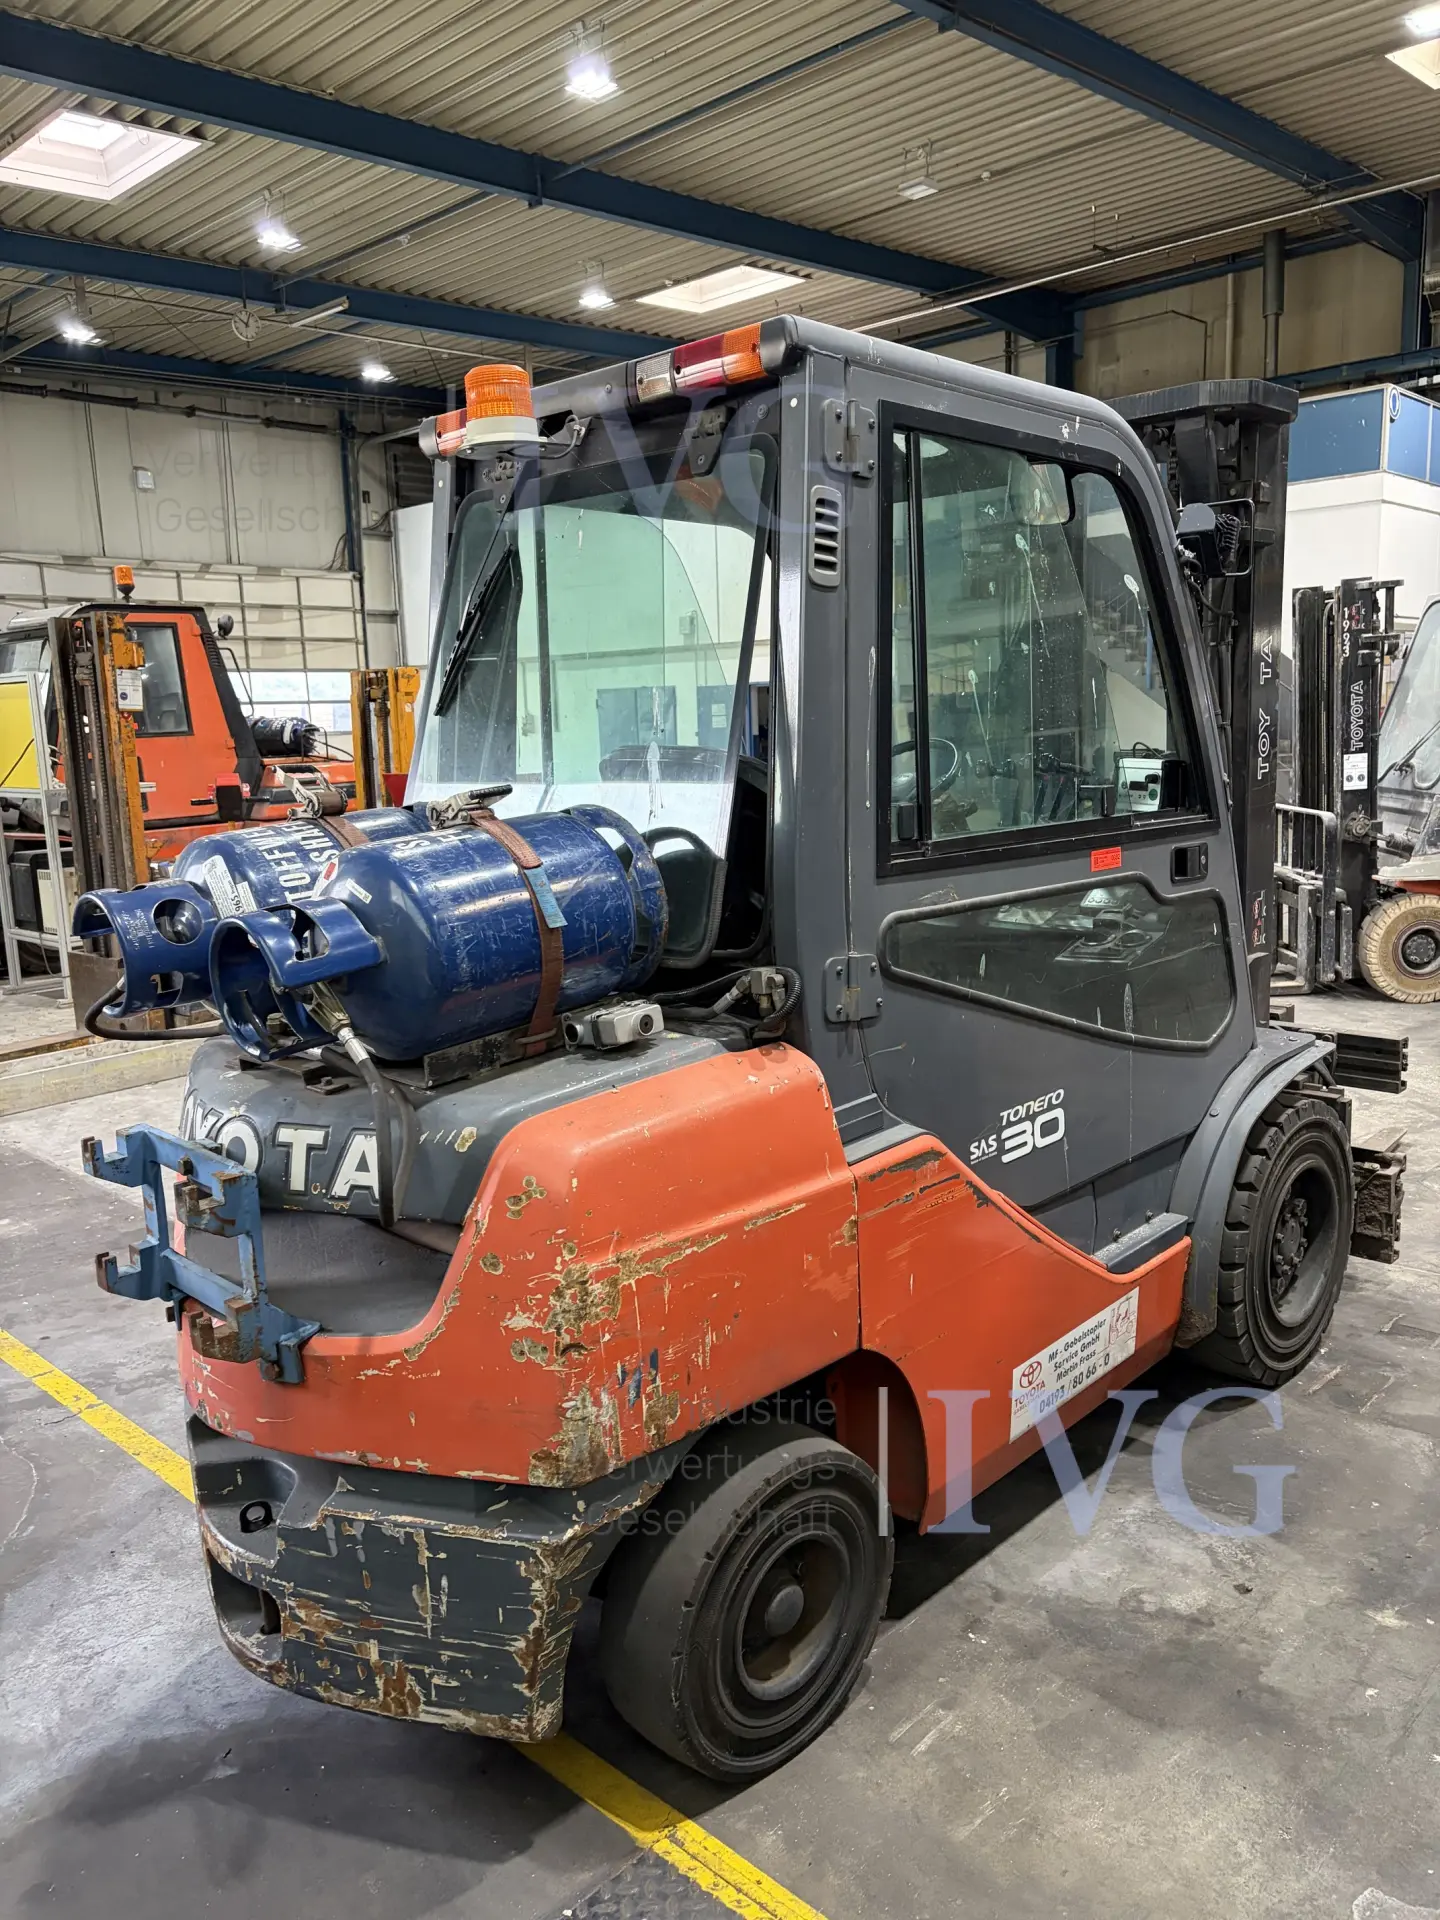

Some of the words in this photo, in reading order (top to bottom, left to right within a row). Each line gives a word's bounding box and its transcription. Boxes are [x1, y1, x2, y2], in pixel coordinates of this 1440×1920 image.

[1342, 606, 1350, 658] 1993
[1350, 680, 1364, 752] TOYOTA
[969, 1134, 998, 1161] SAS
[1001, 1107, 1066, 1164] 30
[1053, 1350, 1079, 1372] Service
[1080, 1332, 1101, 1353] GmbH
[1056, 1361, 1079, 1383] Martin
[1013, 1379, 1046, 1408] TOYOTA
